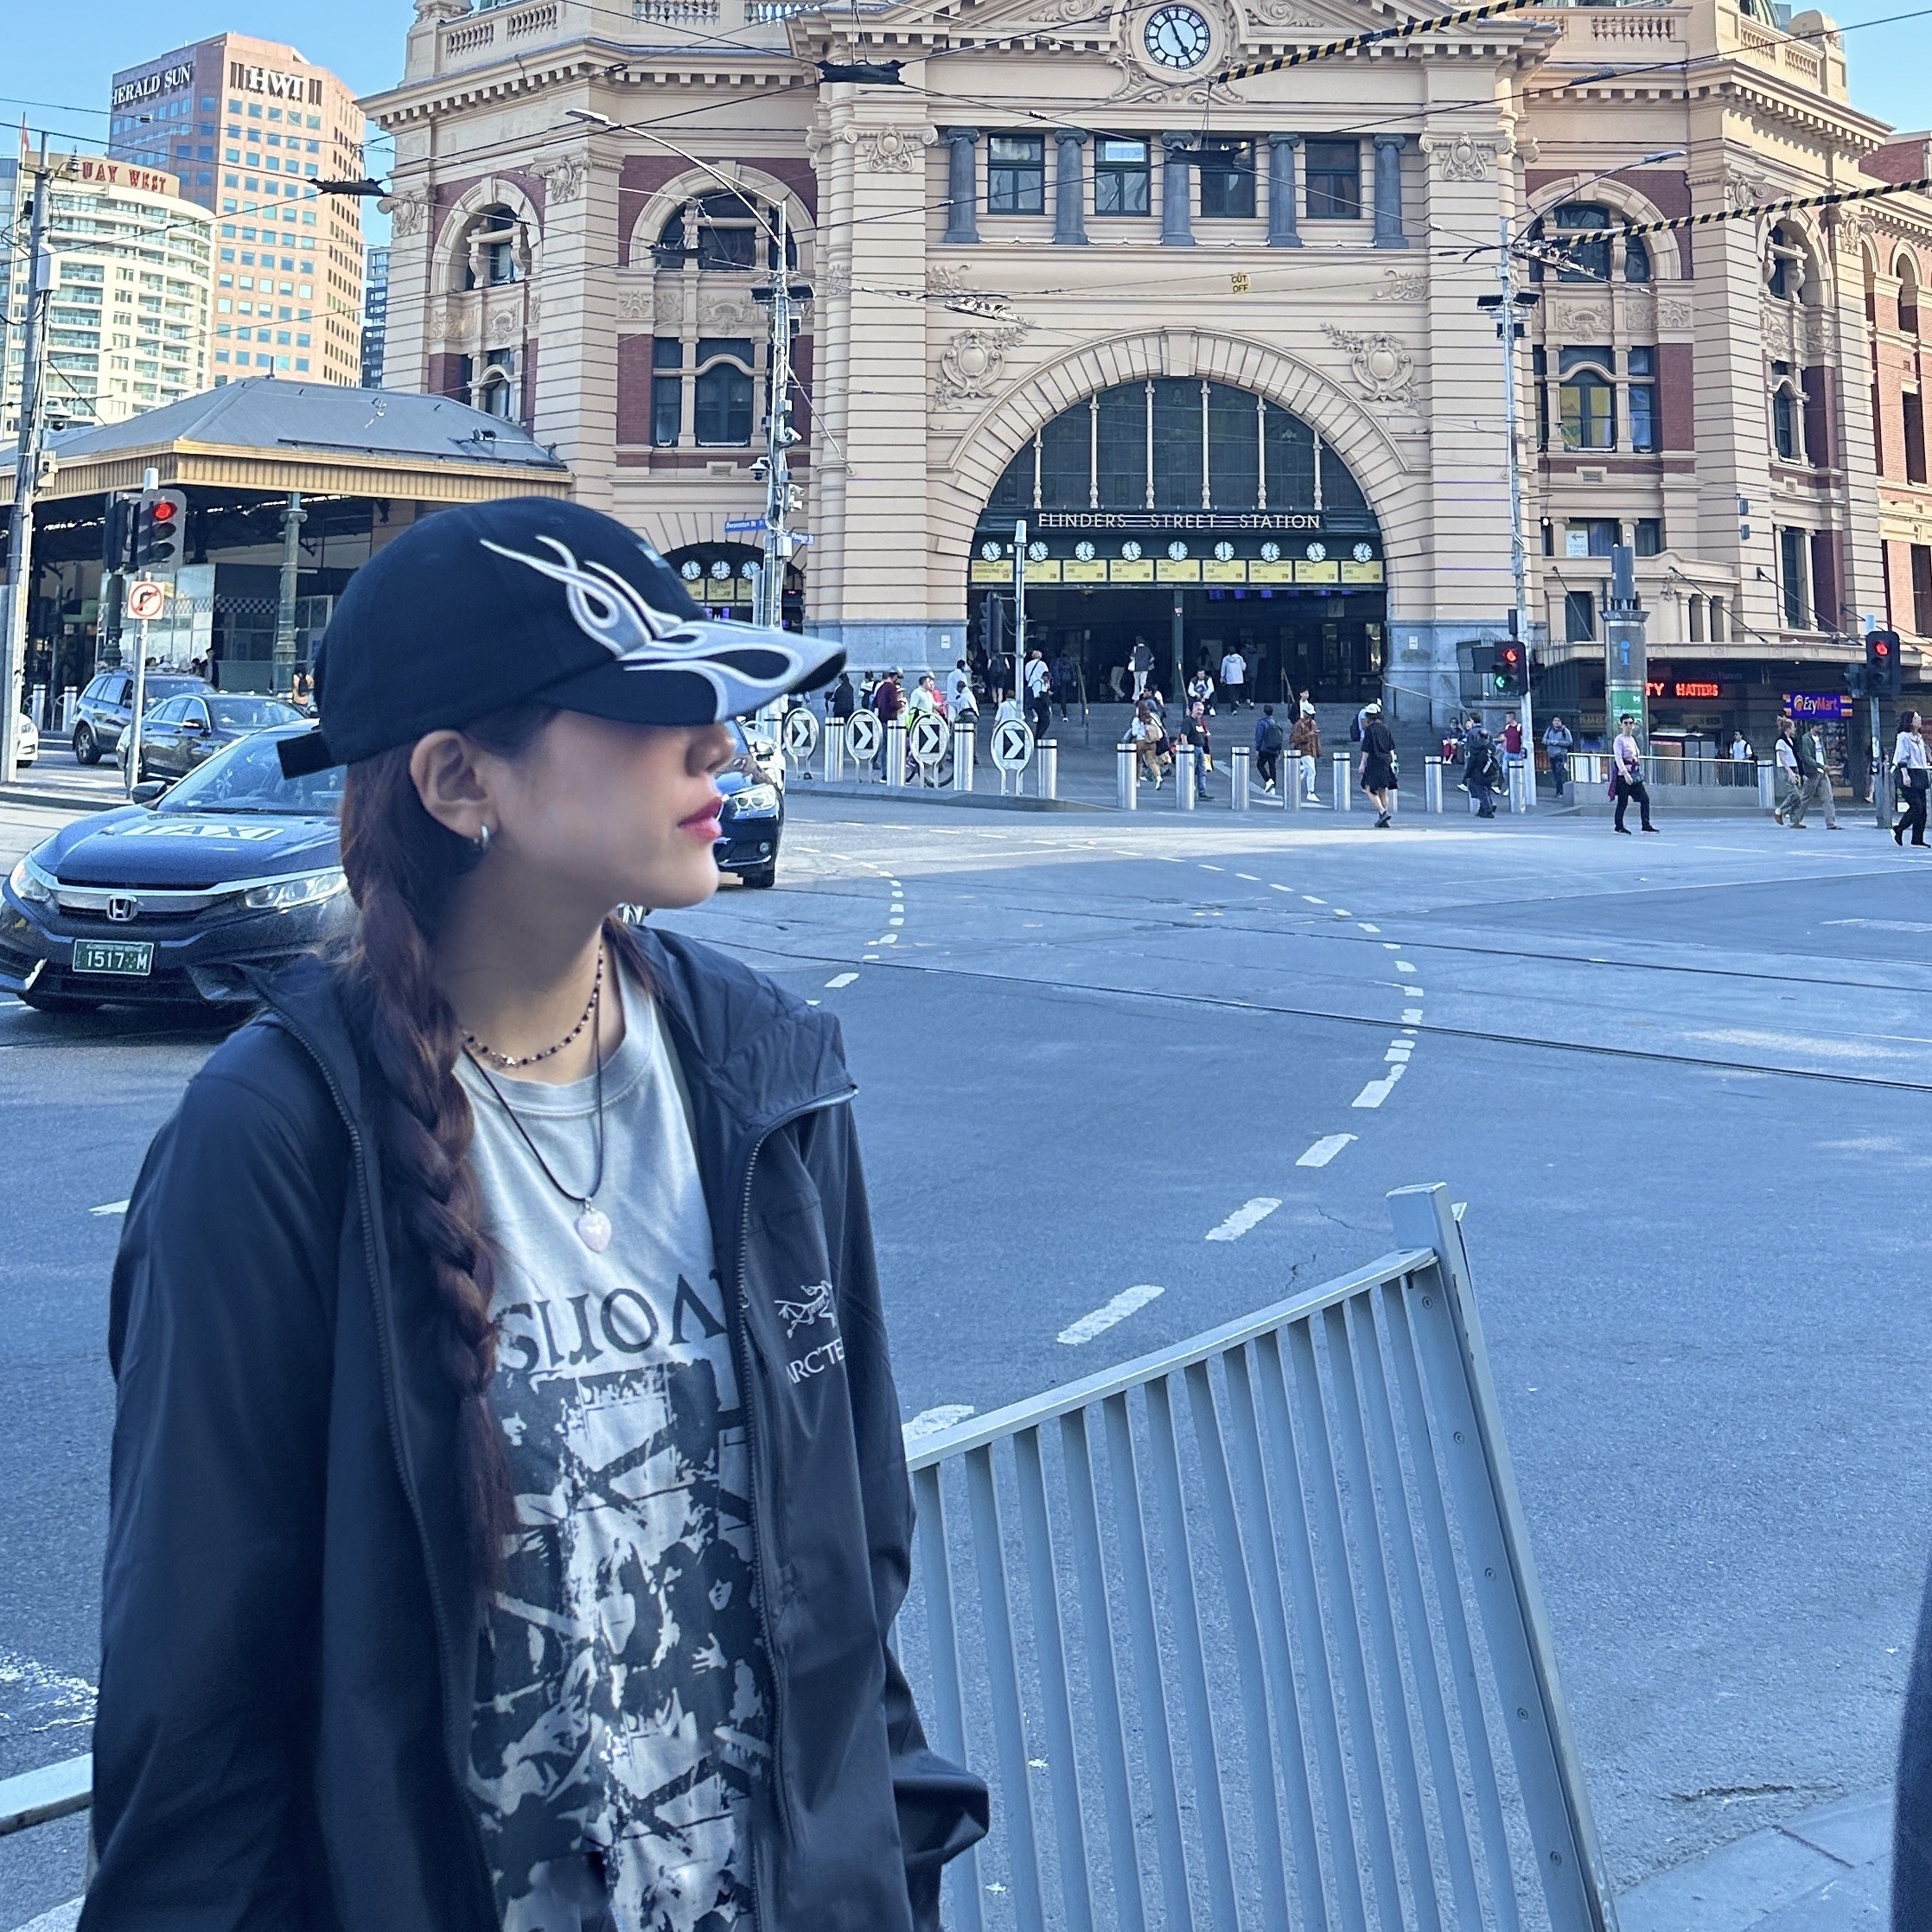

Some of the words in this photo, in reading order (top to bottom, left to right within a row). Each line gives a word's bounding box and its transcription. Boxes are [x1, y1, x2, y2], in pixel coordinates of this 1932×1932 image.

[112, 75, 161, 105] HERALD
[164, 65, 192, 88] SUN
[81, 161, 119, 183] UAY
[128, 169, 167, 194] WEST
[1231, 275, 1247, 284] CUT
[1233, 284, 1248, 293] OFF
[1038, 513, 1126, 528] FLINDERS
[1150, 513, 1217, 529] STREET
[1240, 514, 1320, 529] STATION
[1644, 682, 1665, 697] TY
[1675, 682, 1718, 697] HATTERS
[87, 950, 124, 969] 1517
[136, 953, 148, 971] M
